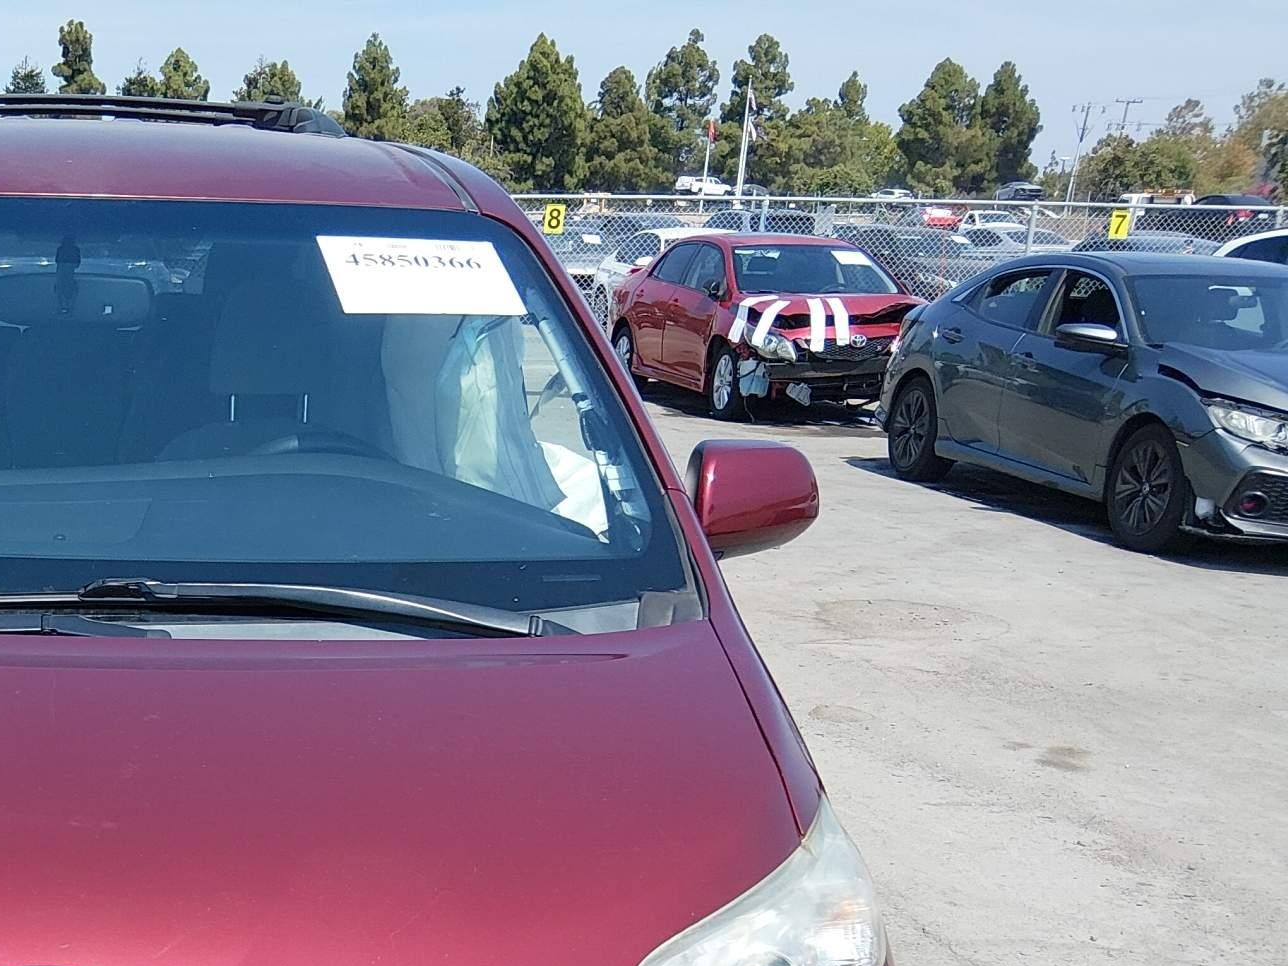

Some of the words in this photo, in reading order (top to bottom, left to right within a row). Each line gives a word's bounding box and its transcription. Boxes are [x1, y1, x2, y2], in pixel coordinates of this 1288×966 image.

[547, 208, 561, 229] 8
[1114, 214, 1128, 235] 7
[344, 252, 482, 270] 45850366
